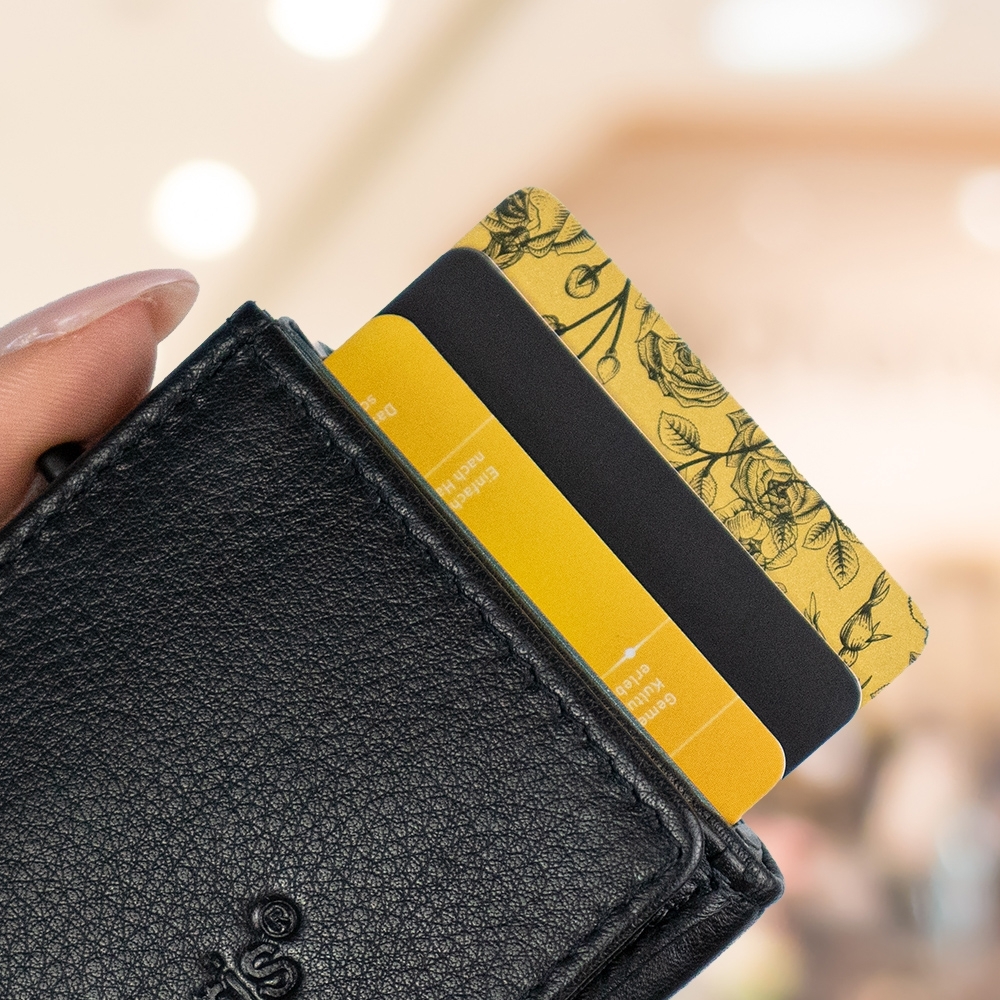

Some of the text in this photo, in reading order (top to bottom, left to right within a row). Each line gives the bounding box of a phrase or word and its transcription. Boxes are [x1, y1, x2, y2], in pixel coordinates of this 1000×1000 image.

[453, 451, 485, 481] nach
[449, 465, 500, 511] Einfach
[615, 663, 650, 695] erleb
